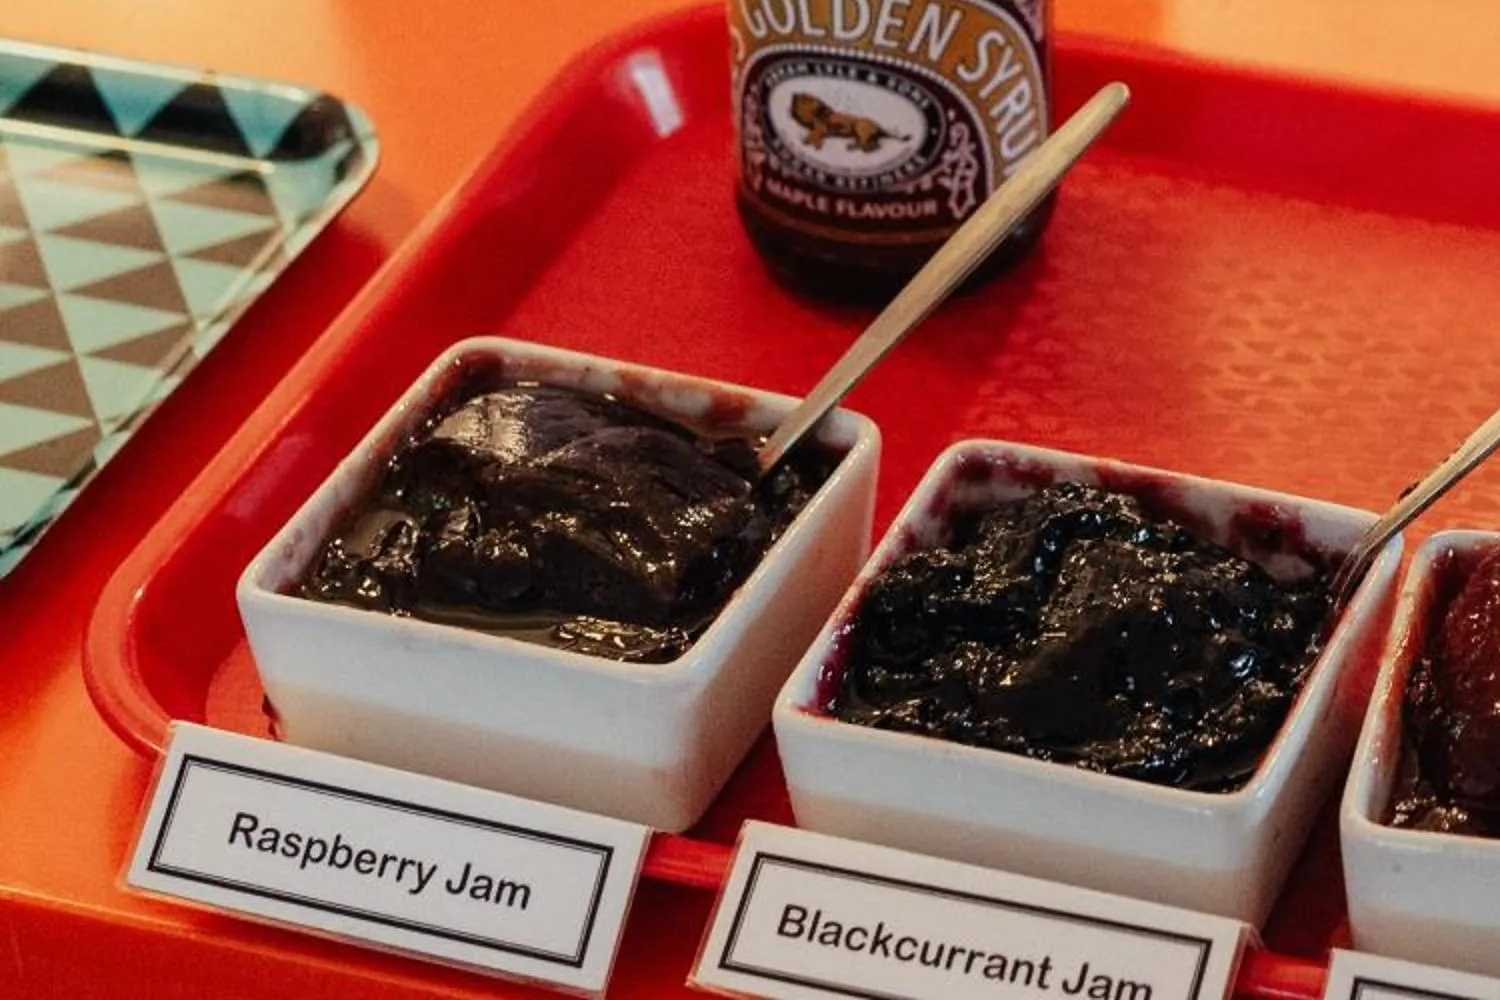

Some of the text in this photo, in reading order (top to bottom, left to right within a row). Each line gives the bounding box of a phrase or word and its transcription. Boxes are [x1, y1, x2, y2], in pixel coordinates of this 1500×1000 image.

[956, 29, 1041, 177] SYRU
[835, 198, 939, 219] FLAVOUR
[227, 811, 532, 911] Raspberry Jam
[775, 902, 1154, 1000] Blackcurrant Jam
